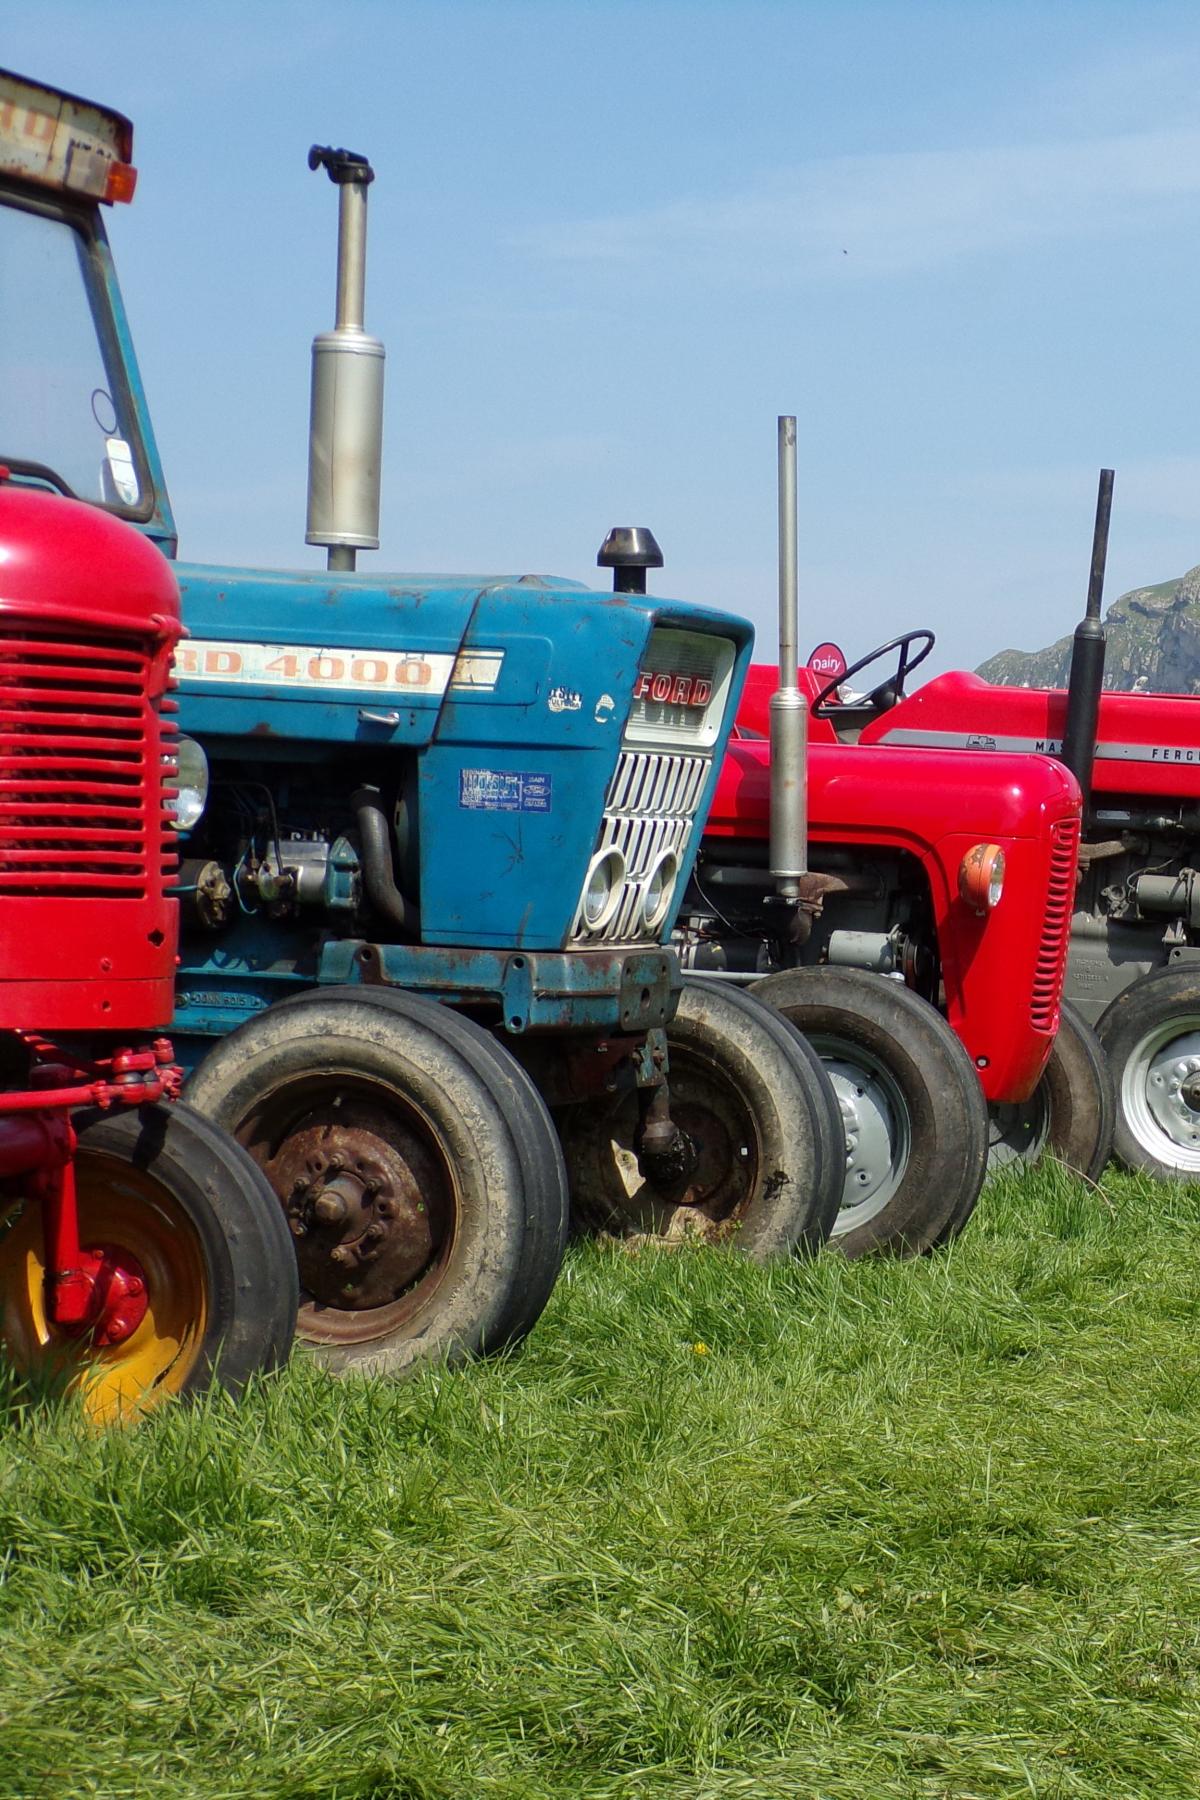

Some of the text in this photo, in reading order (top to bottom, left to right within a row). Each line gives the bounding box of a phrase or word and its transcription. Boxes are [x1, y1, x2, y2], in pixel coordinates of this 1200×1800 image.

[264, 654, 432, 686] 4000
[812, 655, 841, 673] Dairy
[633, 671, 713, 706] FORD
